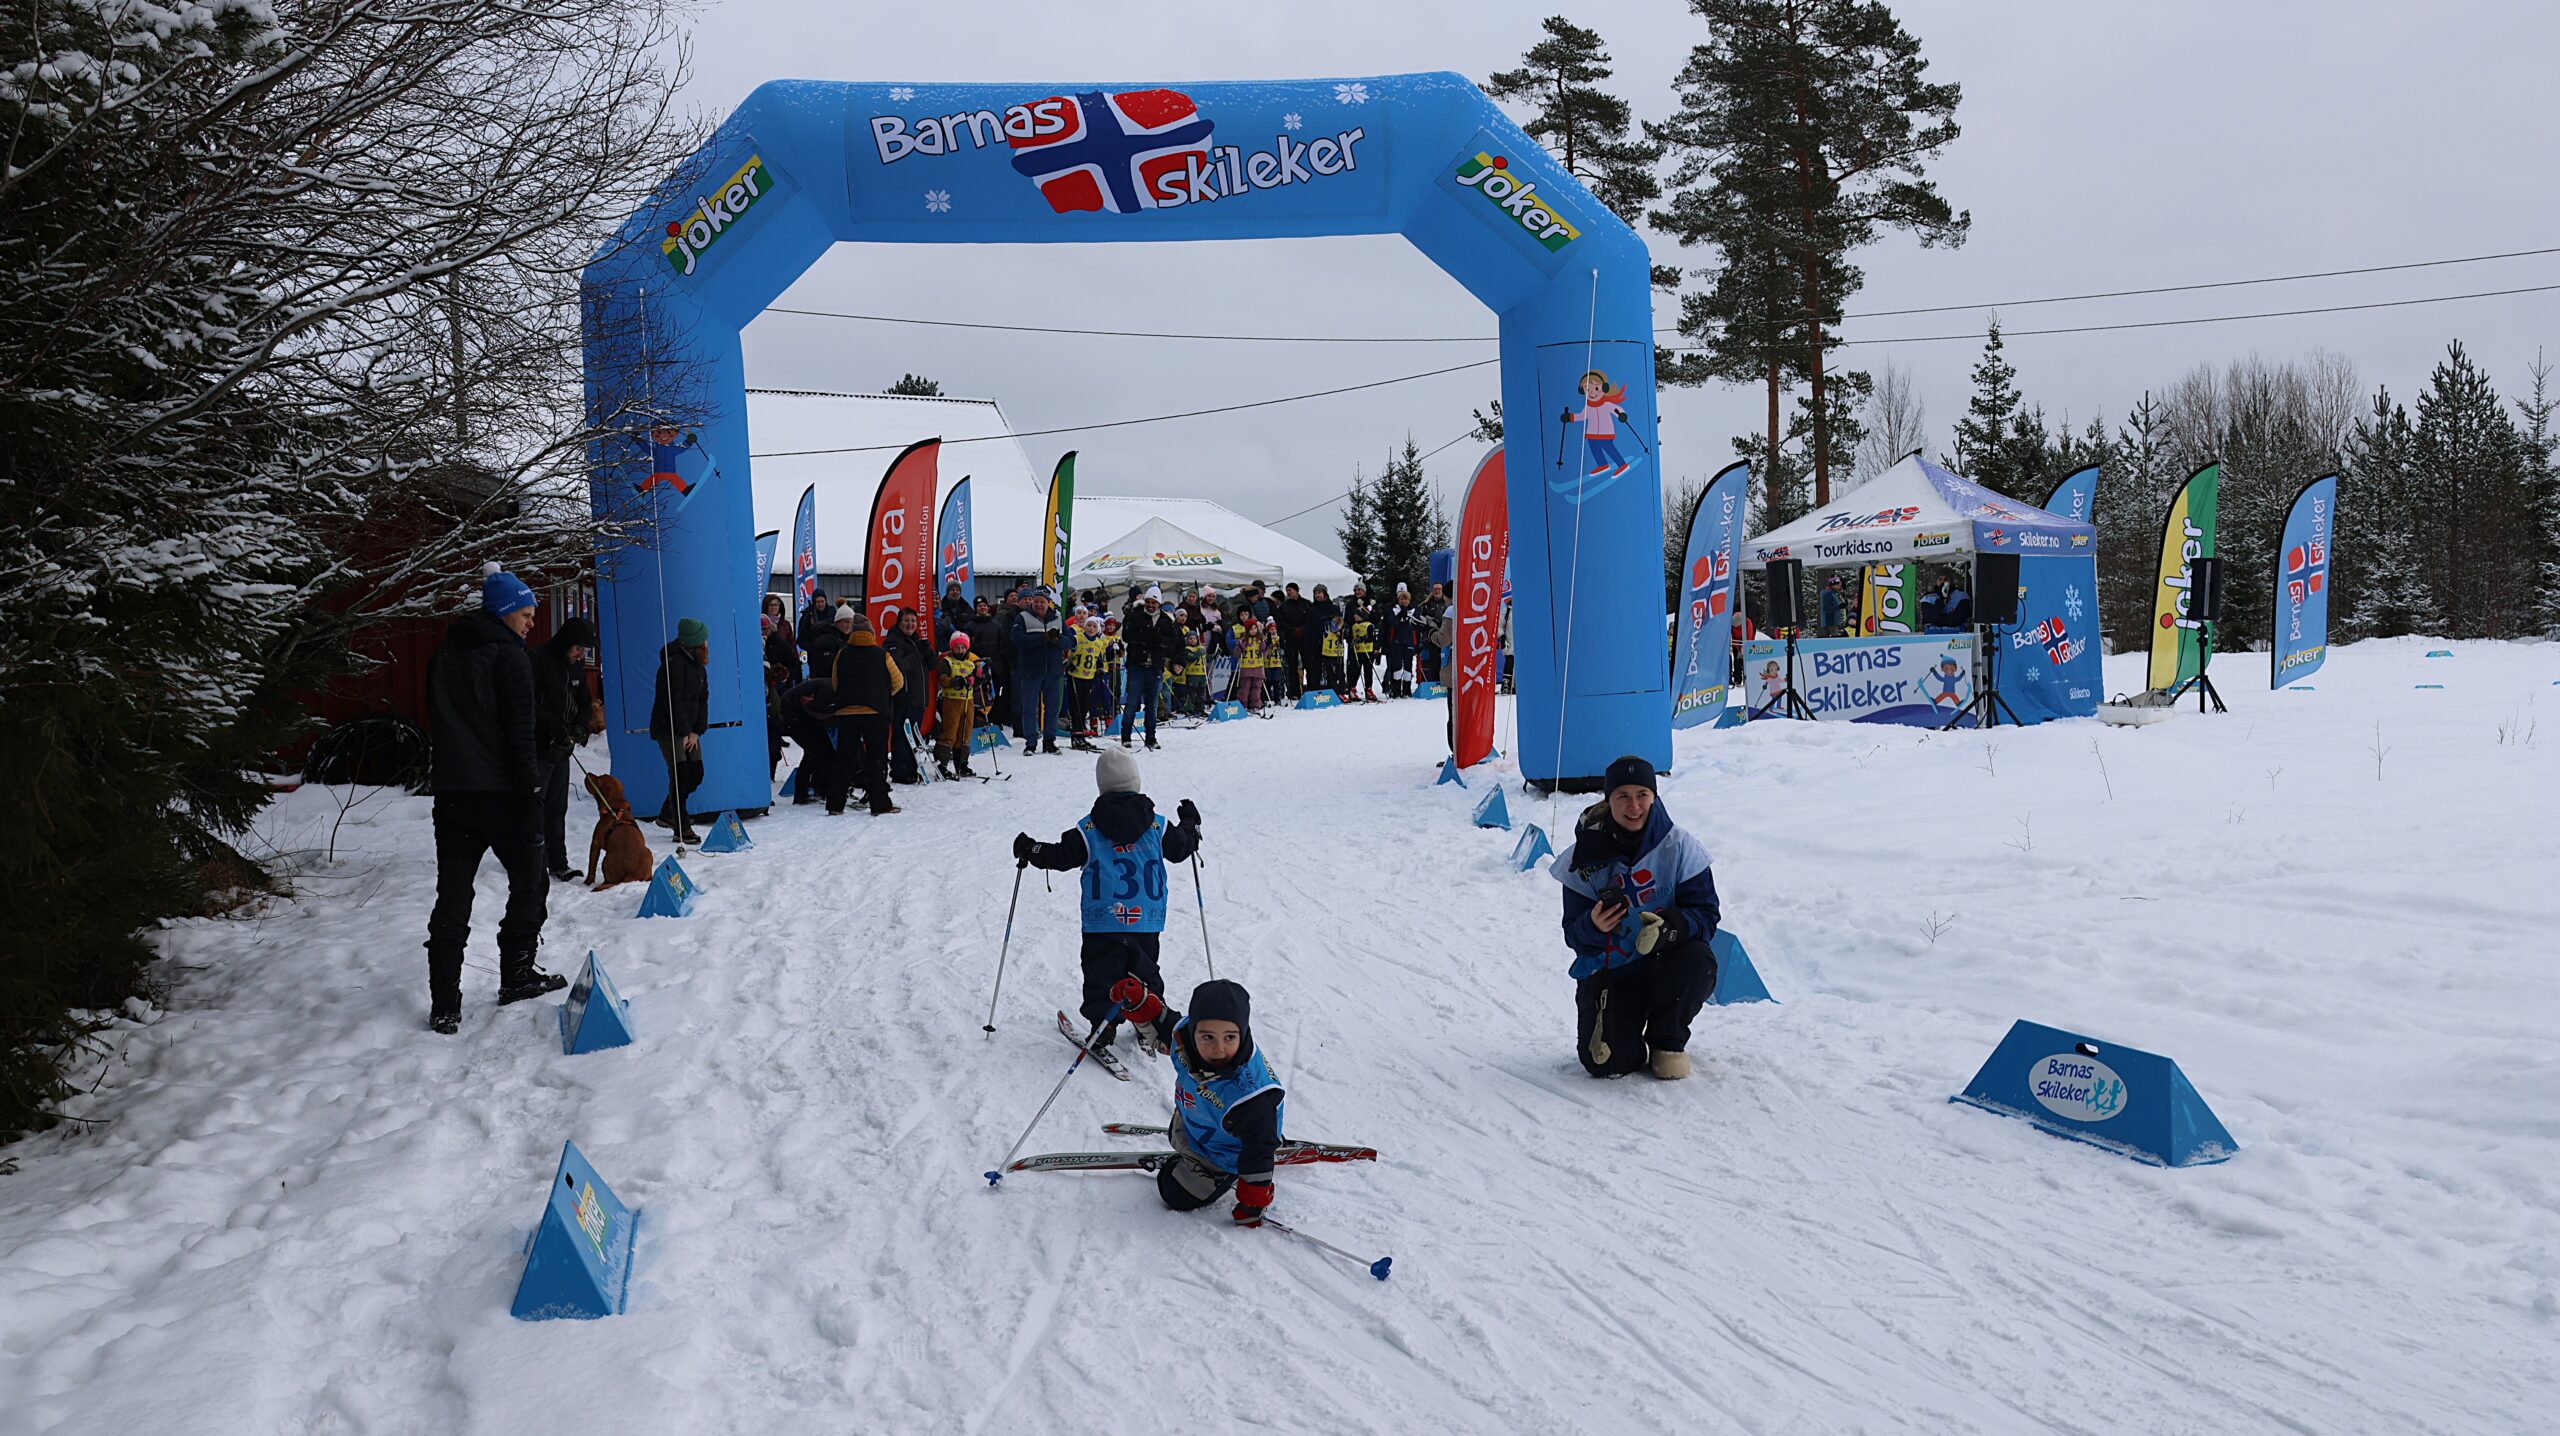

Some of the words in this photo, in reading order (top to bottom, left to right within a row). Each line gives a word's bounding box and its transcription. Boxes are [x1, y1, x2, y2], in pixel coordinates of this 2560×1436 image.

[870, 102, 1065, 164] Barnas
[1157, 127, 1365, 209] skileker
[1455, 156, 1570, 240] joker
[667, 165, 759, 276] joker
[1814, 539, 1893, 558] Tourkids.no
[1915, 533, 1949, 549] joker
[2019, 531, 2060, 549] Skileker.no
[870, 508, 905, 637] plora
[1046, 512, 1068, 608] ker
[1155, 550, 1215, 567] joker
[1865, 564, 1911, 634] jok
[2289, 585, 2302, 642] Barnas
[1813, 647, 1902, 677] Barnas
[2280, 649, 2320, 674] joker
[1674, 687, 1721, 719] joker
[1807, 680, 1908, 714] Skileker
[1088, 858, 1164, 902] 130
[2047, 1059, 2095, 1080] Barnas
[1196, 1085, 1226, 1109] joker
[2036, 1080, 2089, 1102] Skileker
